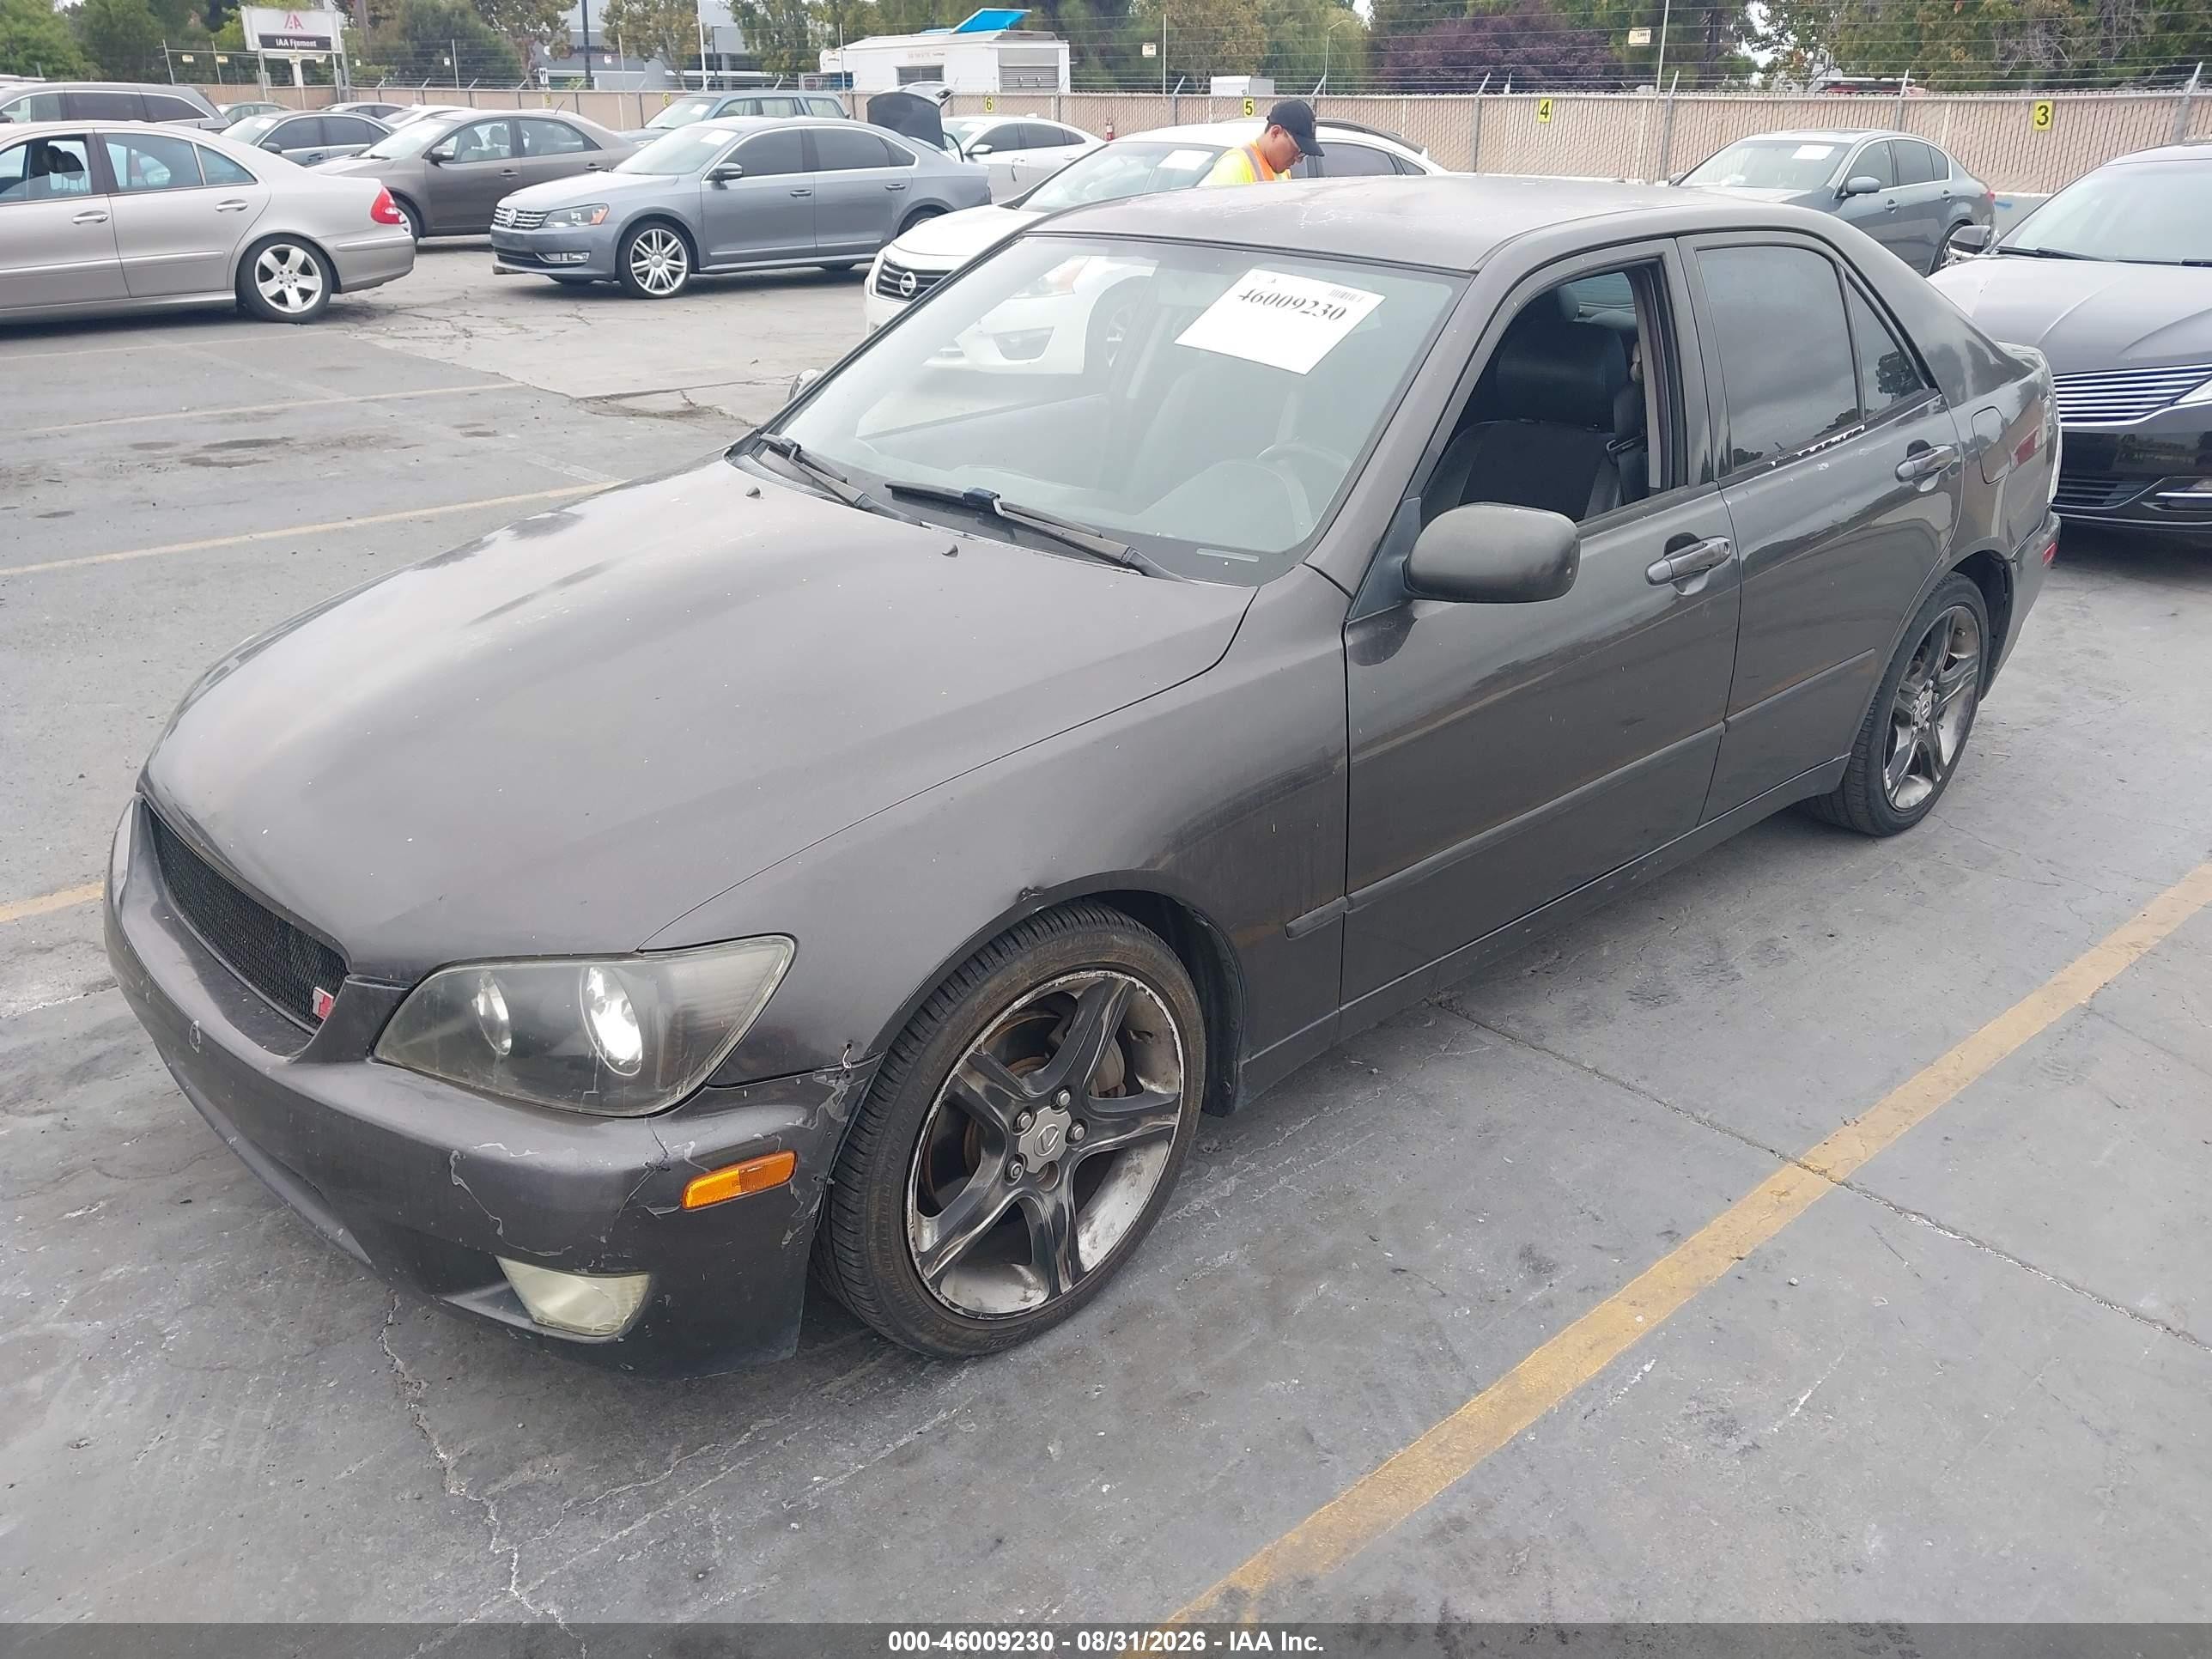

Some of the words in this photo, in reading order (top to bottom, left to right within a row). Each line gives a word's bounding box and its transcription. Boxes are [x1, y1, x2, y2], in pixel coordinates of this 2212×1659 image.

[986, 96, 992, 111] 6
[1245, 100, 1253, 116] 5
[1540, 100, 1550, 118] 4
[2036, 104, 2050, 126] 3
[1238, 289, 1347, 321] 46009230
